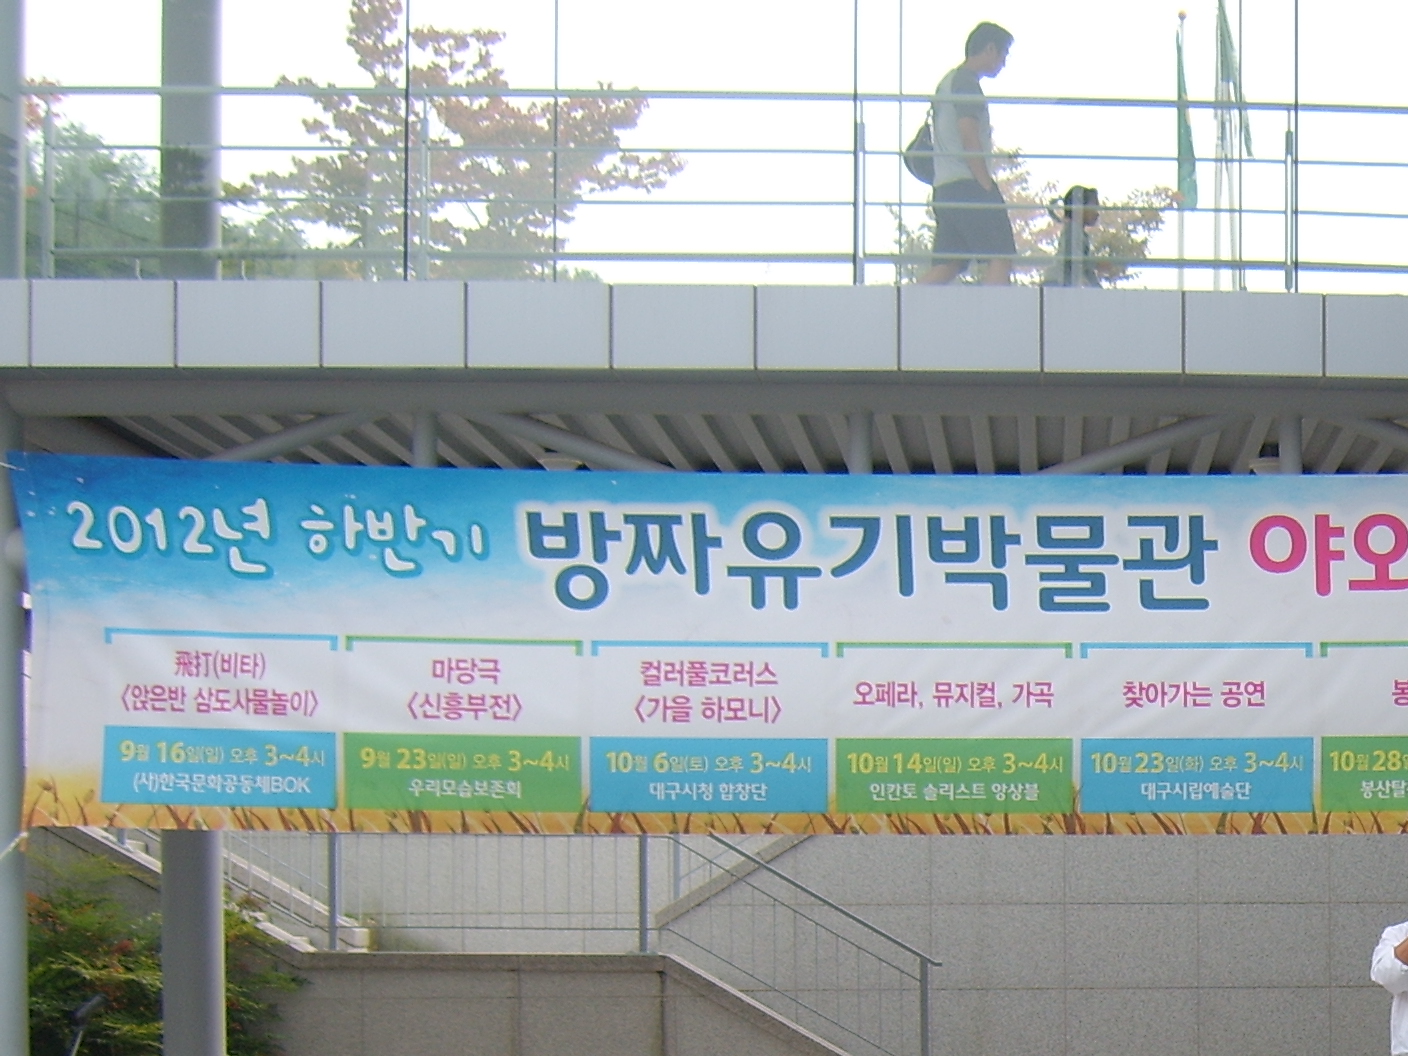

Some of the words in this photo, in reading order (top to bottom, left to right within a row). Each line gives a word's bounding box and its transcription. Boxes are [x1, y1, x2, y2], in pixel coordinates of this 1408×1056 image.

[66, 497, 272, 576] 2012년
[299, 503, 487, 576] 하반기
[525, 510, 1219, 612] 방짜유기박물관
[431, 657, 501, 684] 마당극
[640, 660, 778, 687] 컬러풀코러스
[852, 680, 924, 709] 오페라,
[932, 680, 1003, 709] 뮤지컬,
[1011, 681, 1055, 708] 가곡
[1122, 680, 1213, 709] 찾아가는
[1220, 680, 1266, 708] 공연
[119, 740, 149, 762] 9월
[157, 741, 224, 764] 16일(일)
[230, 748, 259, 765] 오후
[359, 748, 390, 769] 9월
[396, 748, 466, 770] 23일(일)
[472, 754, 502, 770] 오후
[606, 752, 647, 773] 10월
[653, 752, 709, 773] 6일(토)
[714, 756, 744, 773] 오후
[847, 752, 888, 774] 10월
[893, 752, 962, 774] 14일(일)
[966, 756, 996, 773] 오후
[1091, 752, 1131, 774] 10월
[1134, 752, 1204, 774] 23일(화)
[1208, 756, 1238, 772] 오후
[1329, 750, 1369, 772] 10월
[408, 778, 522, 799] 우리모습보존회
[649, 782, 714, 801] 대구시청
[719, 782, 768, 801] 합창단
[869, 783, 918, 801] 인칸토
[923, 783, 987, 801] 솔리스트
[991, 783, 1039, 801] 앙상블
[1140, 782, 1251, 800] 대구시립예술단
